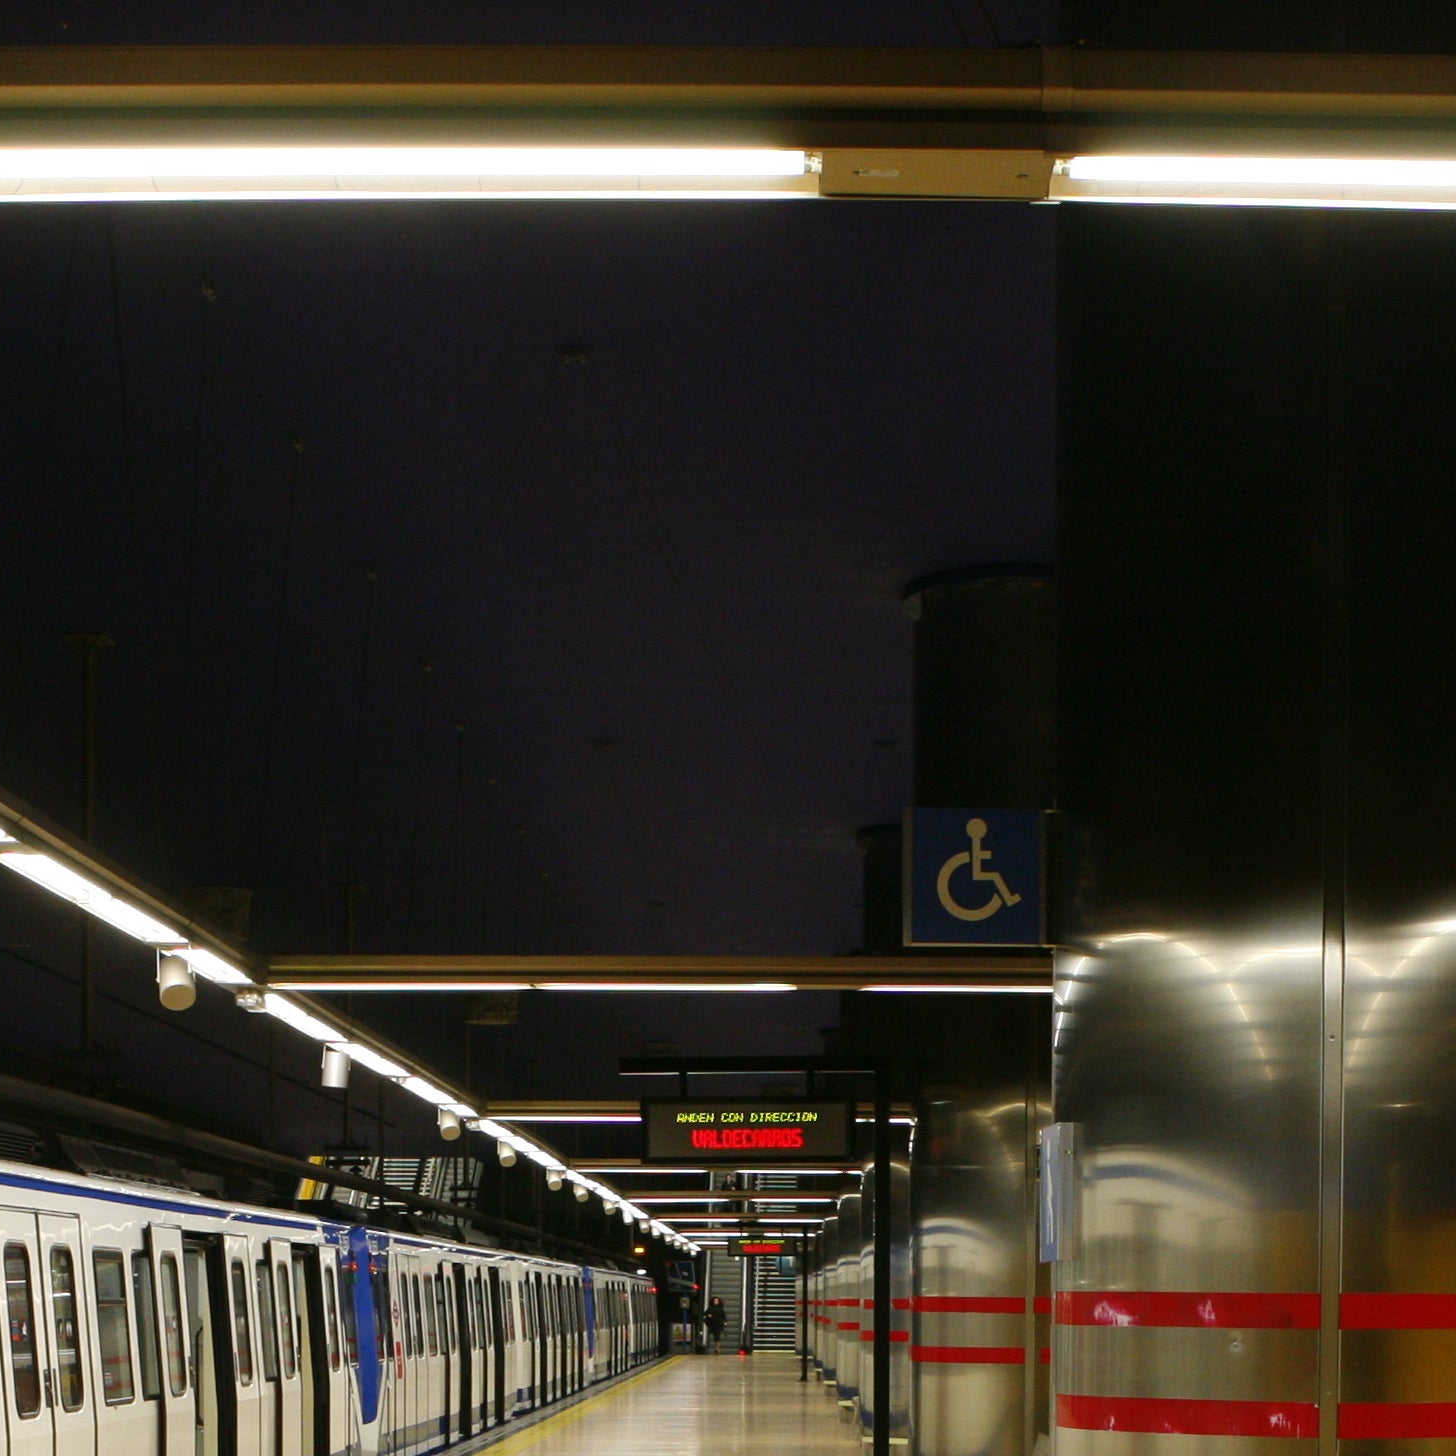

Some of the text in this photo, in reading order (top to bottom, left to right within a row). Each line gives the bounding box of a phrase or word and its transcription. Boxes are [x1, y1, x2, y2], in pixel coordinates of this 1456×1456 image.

[676, 1111, 818, 1123] ANDEN CON DIRECCION
